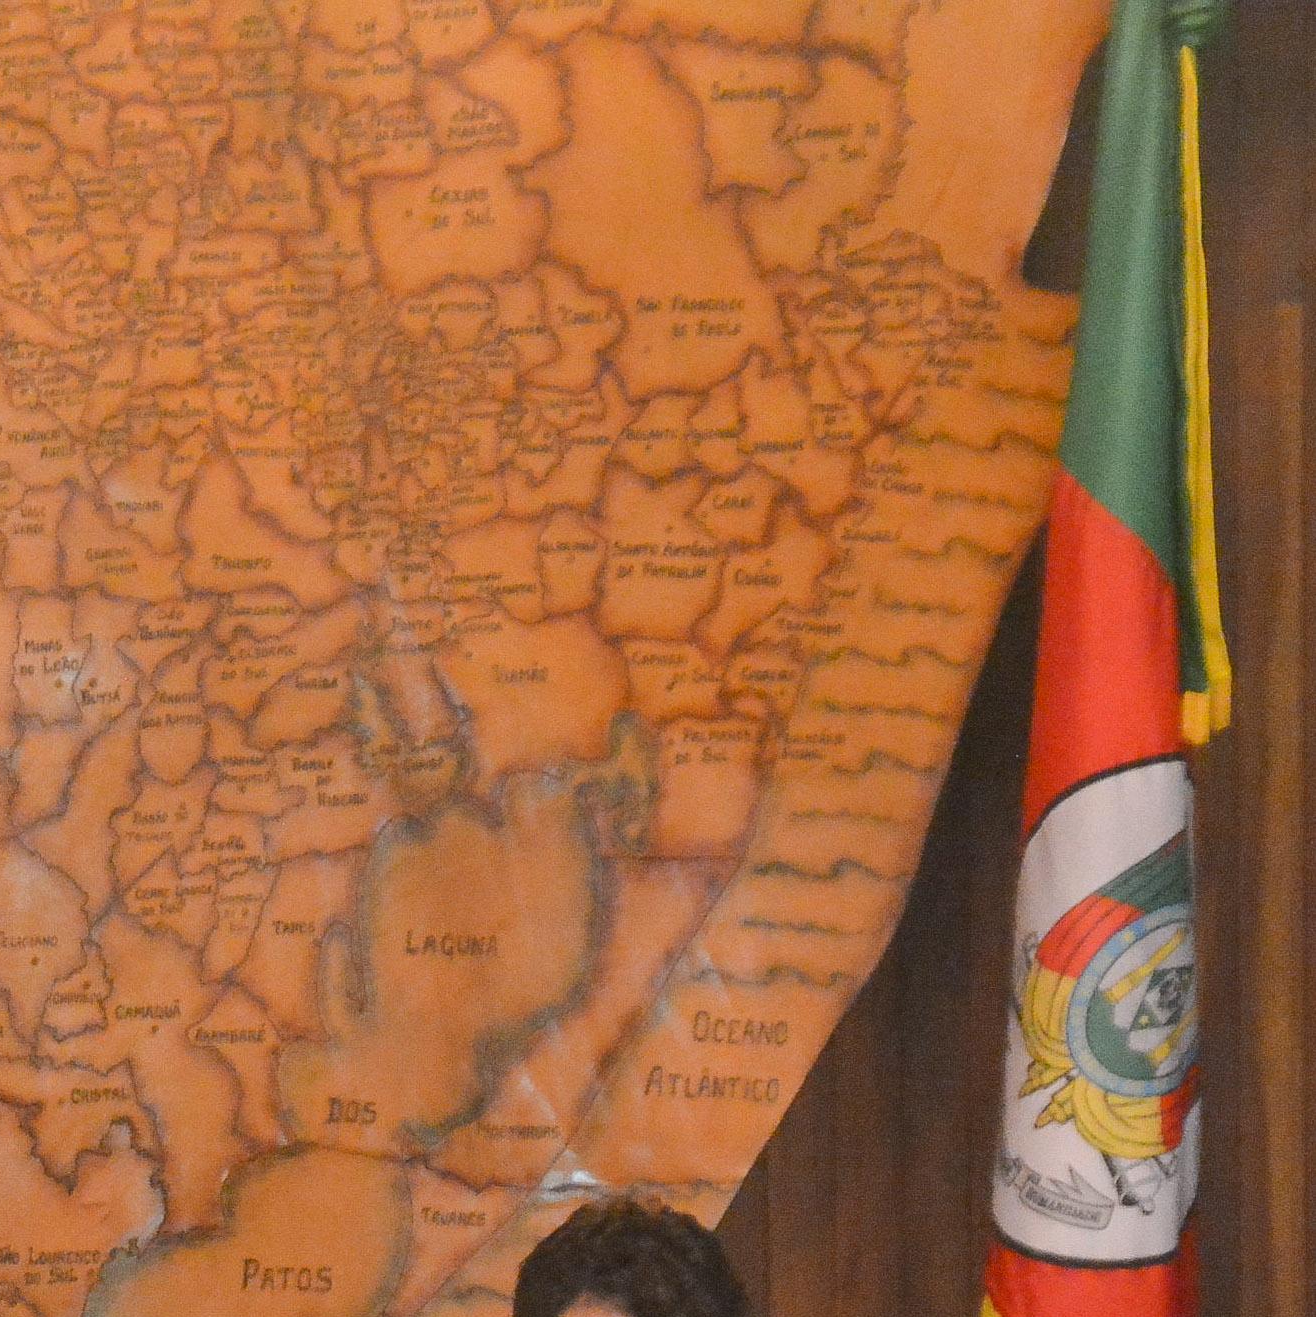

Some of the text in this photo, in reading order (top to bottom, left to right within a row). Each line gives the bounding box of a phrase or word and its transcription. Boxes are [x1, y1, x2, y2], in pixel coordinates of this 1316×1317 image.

[406, 931, 498, 958] LAGUNA
[692, 1011, 788, 1045] OCEANO
[645, 1066, 781, 1101] ATLÂNTICO
[328, 1098, 377, 1125] DOS
[242, 1257, 332, 1294] PATOS
